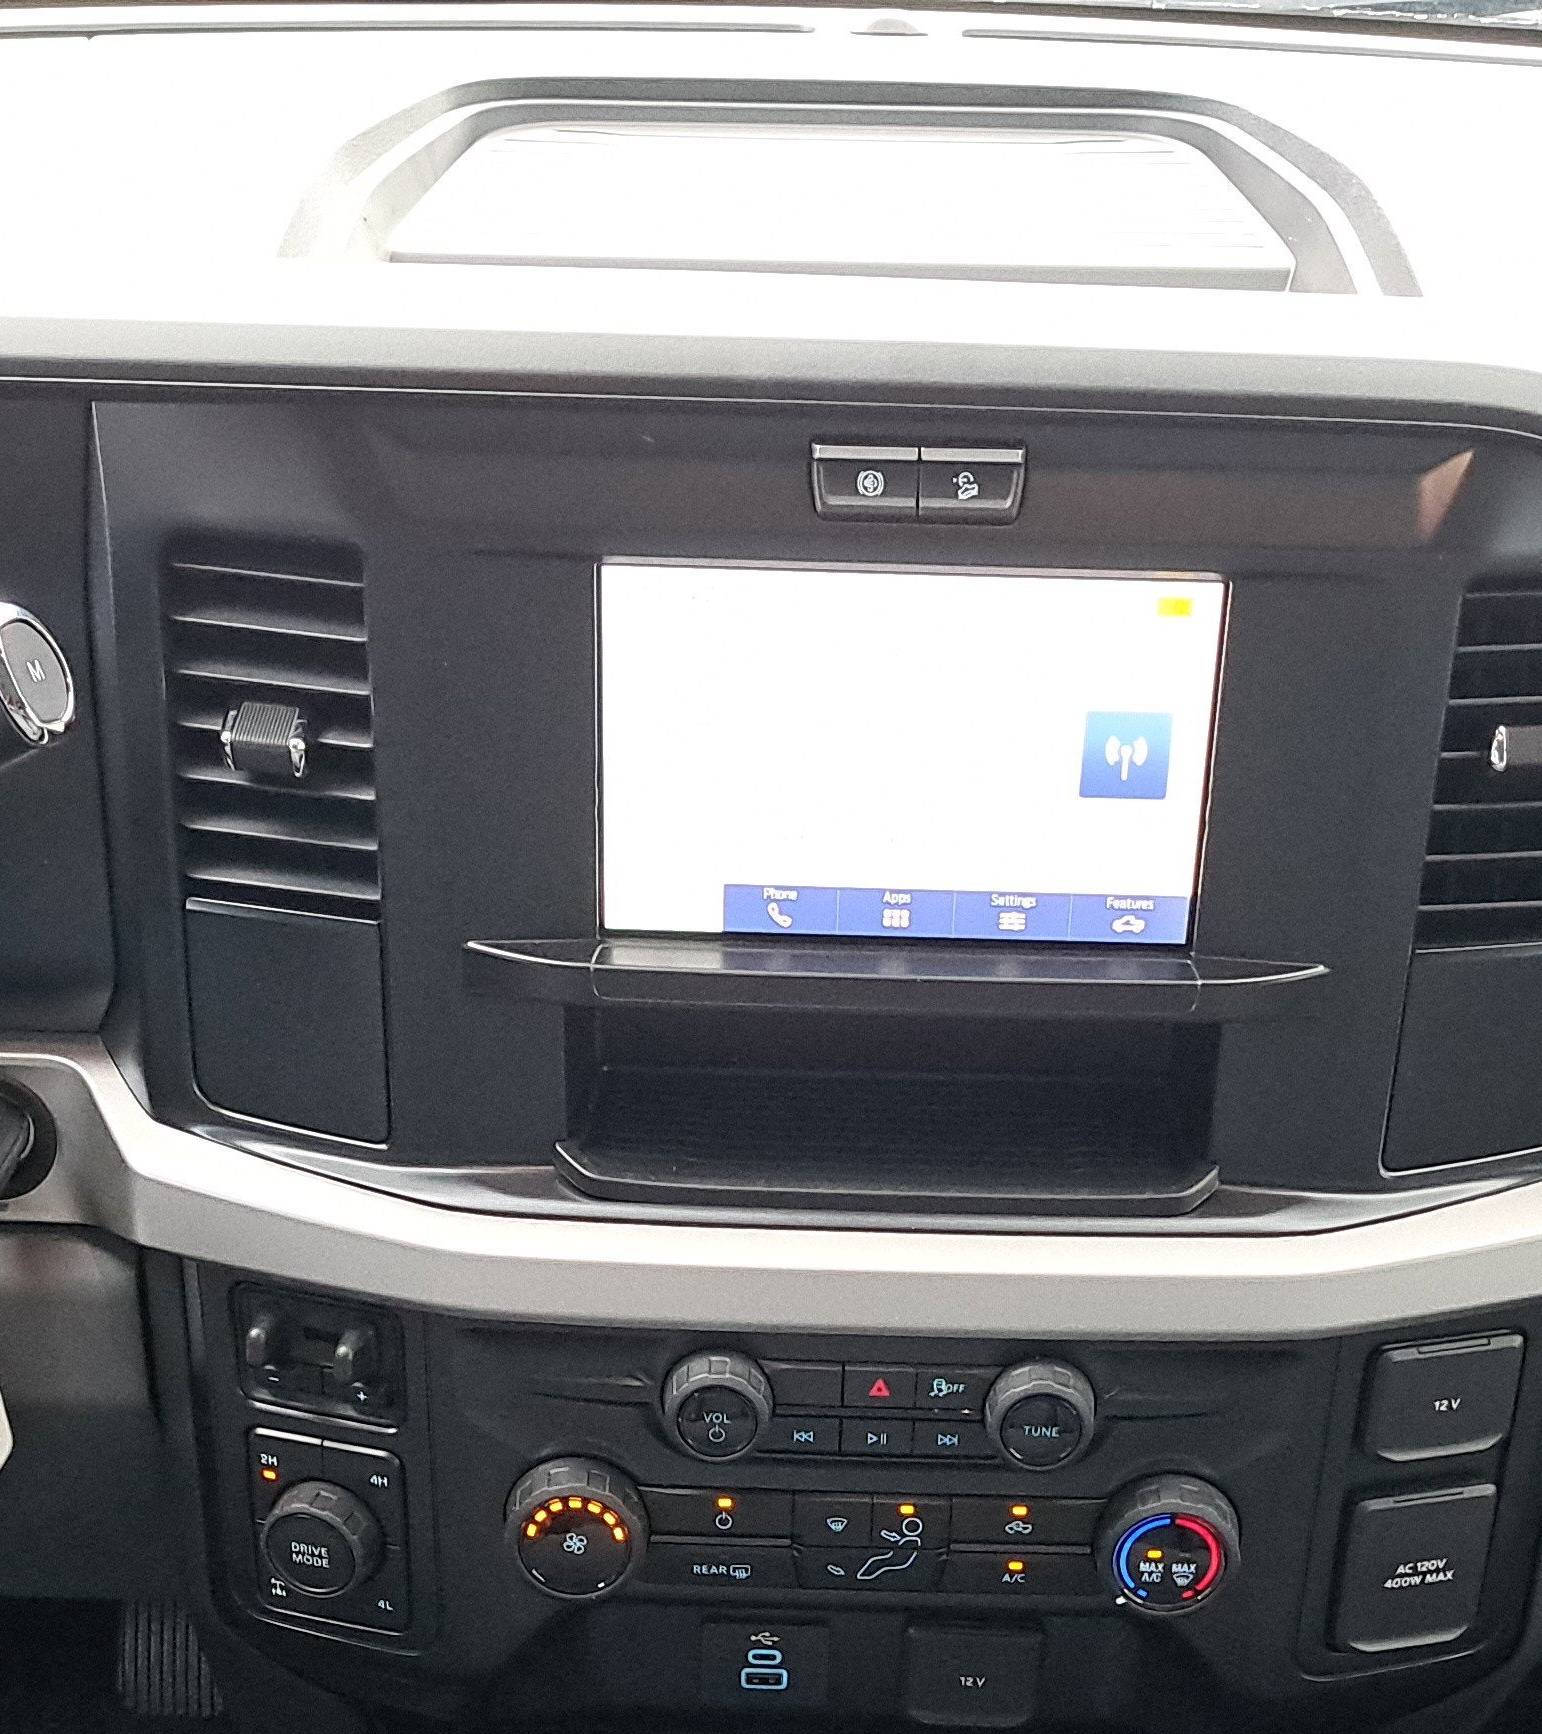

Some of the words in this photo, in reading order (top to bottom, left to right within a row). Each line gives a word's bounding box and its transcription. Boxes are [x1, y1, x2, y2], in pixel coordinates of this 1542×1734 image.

[26, 660, 46, 683] M
[763, 887, 798, 900] Phone
[882, 891, 912, 905] Apps
[990, 894, 1037, 909] Settings
[1106, 897, 1155, 910] Features
[946, 1383, 966, 1394] OFF
[1433, 1399, 1448, 1412] 12
[702, 1412, 732, 1425] VOL
[1022, 1424, 1060, 1438] TUNE
[260, 1453, 278, 1467] 2H
[370, 1474, 388, 1488] 4H
[291, 1541, 329, 1558] DRIVE
[291, 1553, 330, 1568] MODE
[1139, 1560, 1165, 1573] MAX
[1394, 1562, 1414, 1575] AC
[1416, 1558, 1449, 1572] 120V
[692, 1564, 728, 1576] REAR
[1171, 1563, 1197, 1573] MAX
[1001, 1573, 1026, 1584] A/C
[1141, 1572, 1162, 1583] A/C
[1383, 1574, 1422, 1589] 400W
[1425, 1569, 1454, 1584] MAX
[377, 1599, 394, 1611] 4L
[960, 1675, 974, 1687] 12
